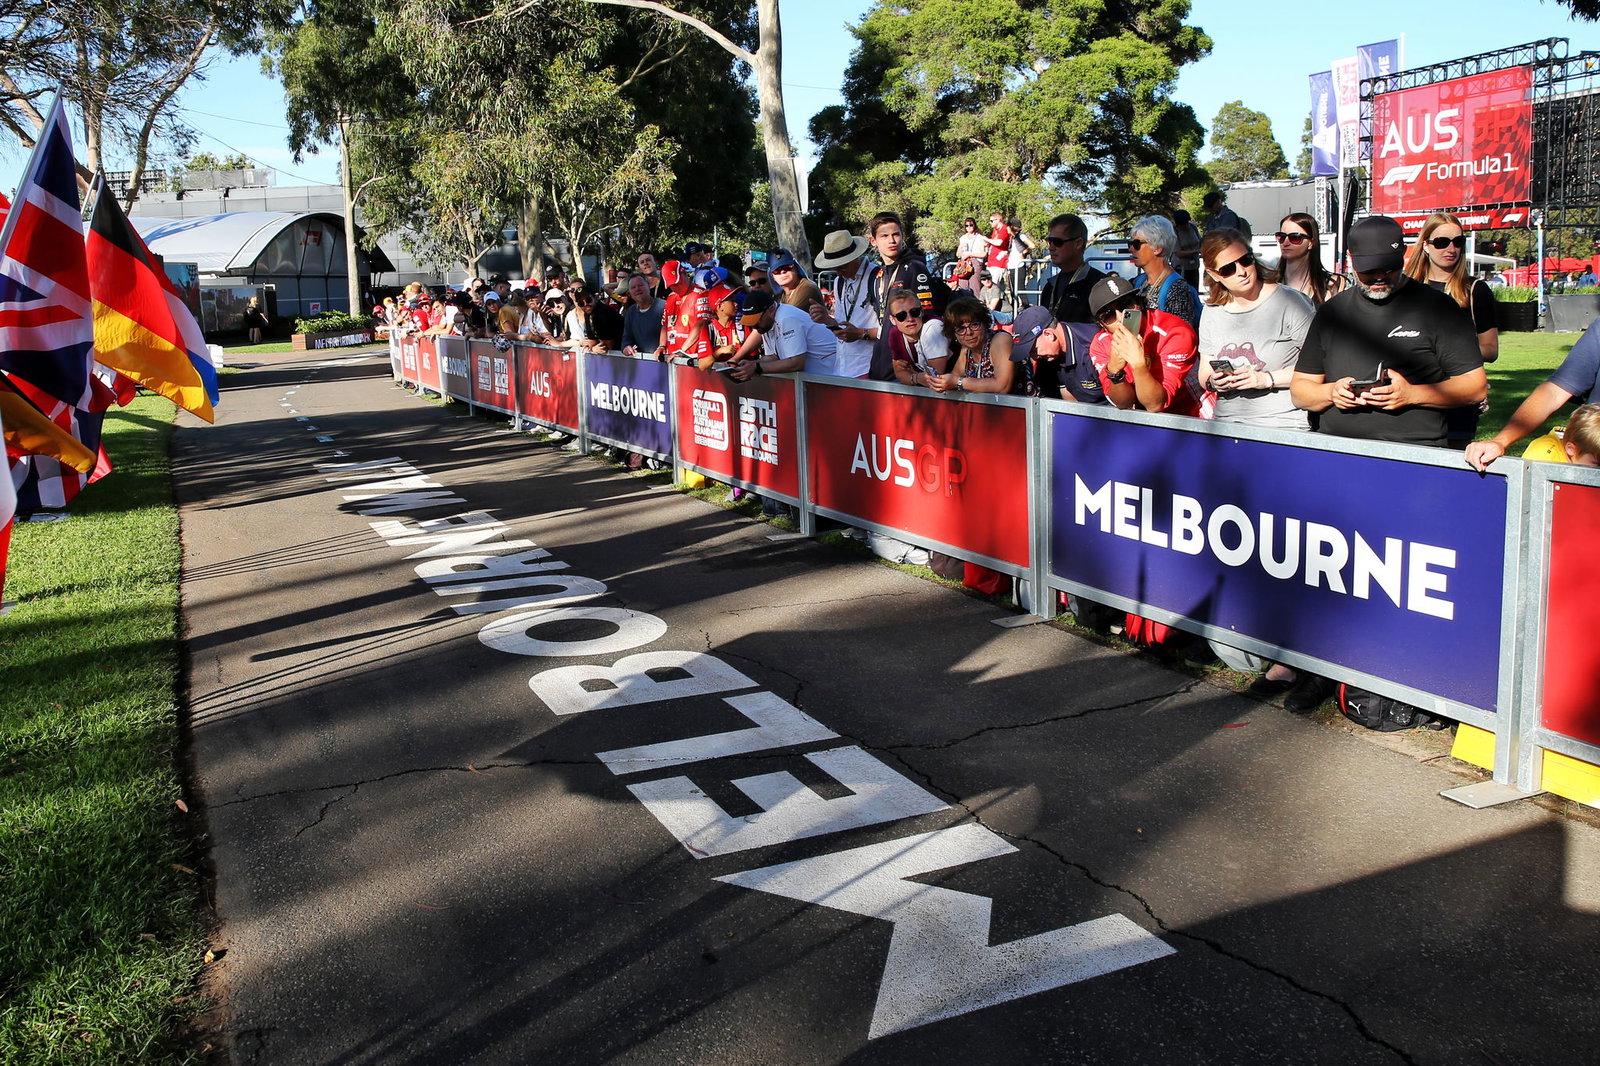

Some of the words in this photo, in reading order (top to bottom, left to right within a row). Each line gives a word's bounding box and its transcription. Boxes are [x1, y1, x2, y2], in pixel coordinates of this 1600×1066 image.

[590, 380, 667, 423] MELBOURNE
[738, 396, 778, 428] 25TH
[739, 421, 778, 453] RACE
[1075, 473, 1457, 621] MELBOURNE
[368, 511, 1178, 1040] MELBOURNE
